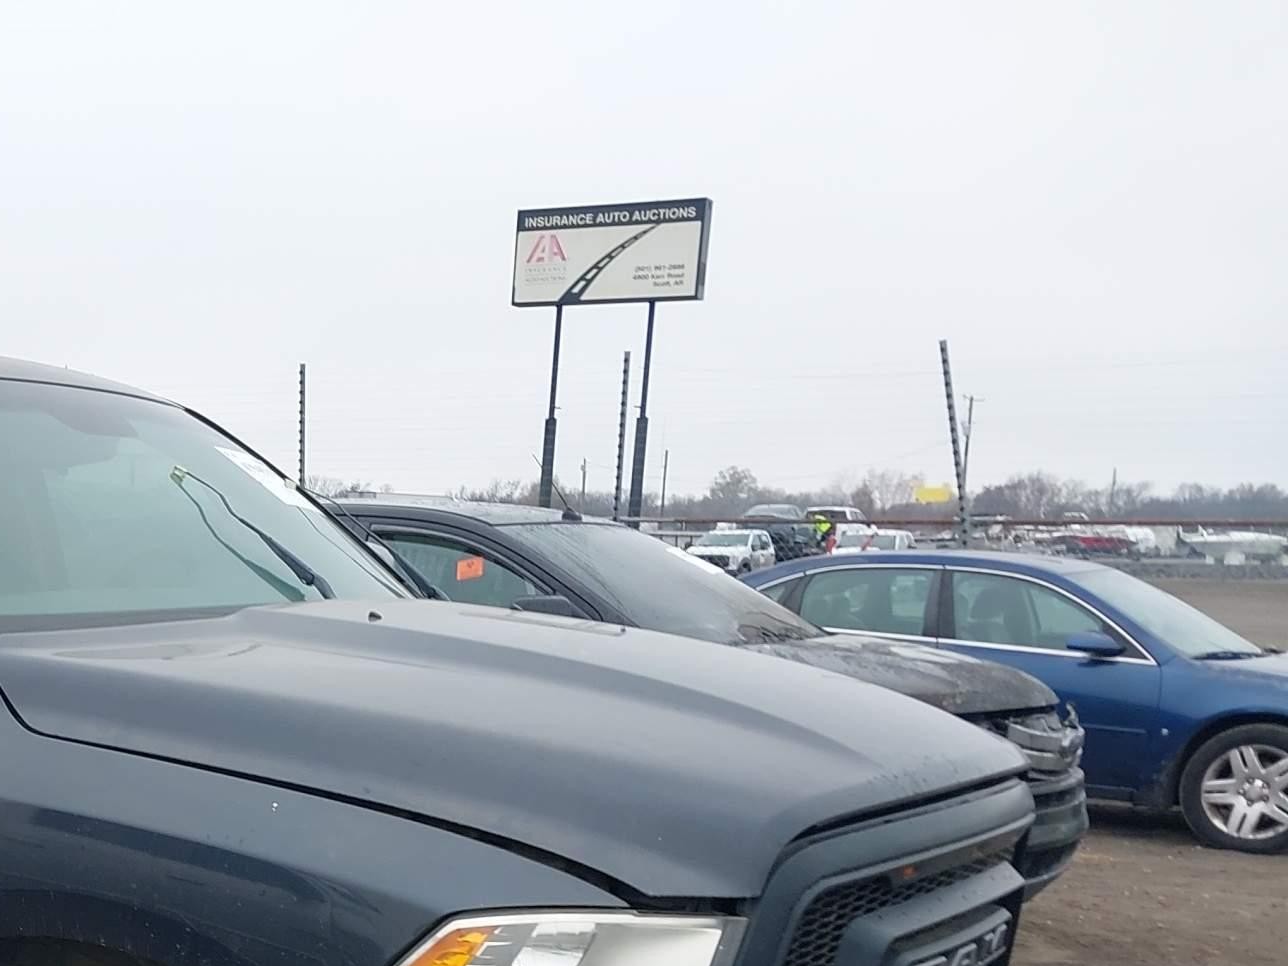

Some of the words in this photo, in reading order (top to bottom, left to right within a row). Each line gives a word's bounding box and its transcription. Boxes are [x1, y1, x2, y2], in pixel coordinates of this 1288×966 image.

[525, 213, 594, 228] INSURANCE
[596, 210, 630, 225] AUTO
[632, 206, 697, 222] AUCTIONS
